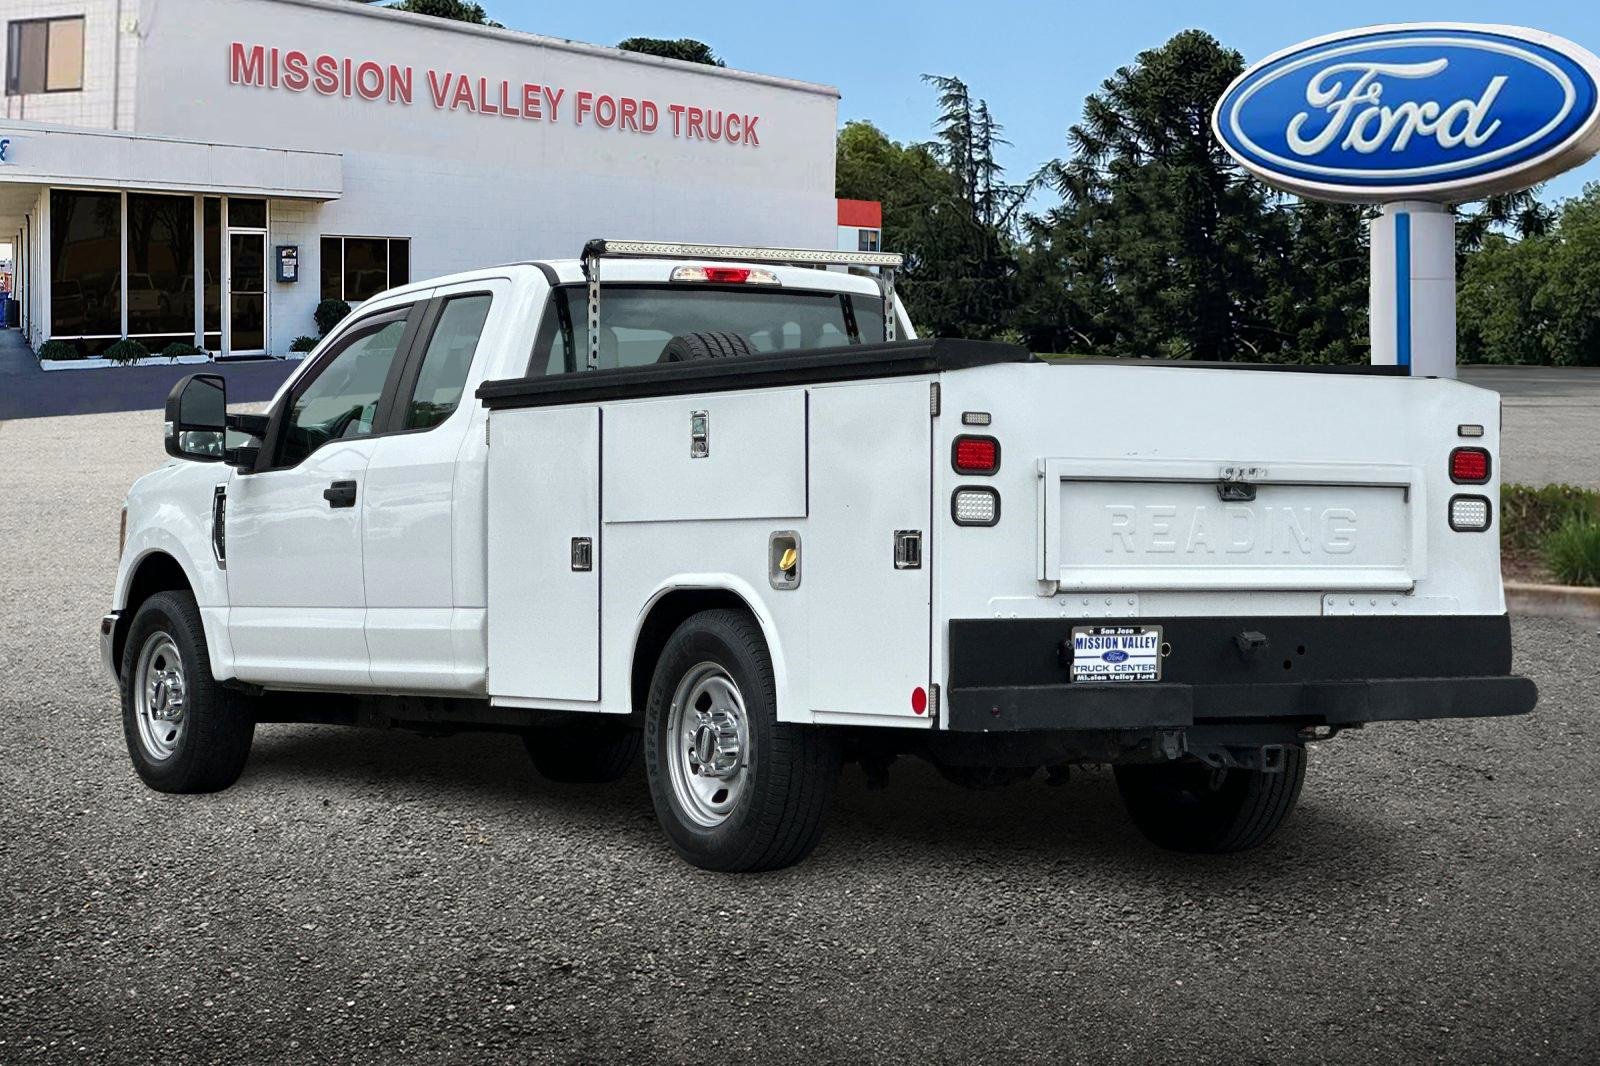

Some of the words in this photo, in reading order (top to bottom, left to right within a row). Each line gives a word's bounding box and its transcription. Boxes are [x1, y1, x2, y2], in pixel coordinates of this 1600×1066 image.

[229, 42, 413, 105] MISSION
[426, 68, 566, 121] VALLEY
[575, 90, 660, 134] FORD
[668, 103, 762, 146] TRUCK
[1286, 57, 1509, 156] Ford
[1104, 504, 1358, 554] READING
[1075, 637, 1118, 650] MISSION
[1122, 636, 1157, 649] VALLEY
[1106, 652, 1124, 661] Ford
[1074, 664, 1109, 672] TRUCK
[1114, 664, 1156, 672] CENTER
